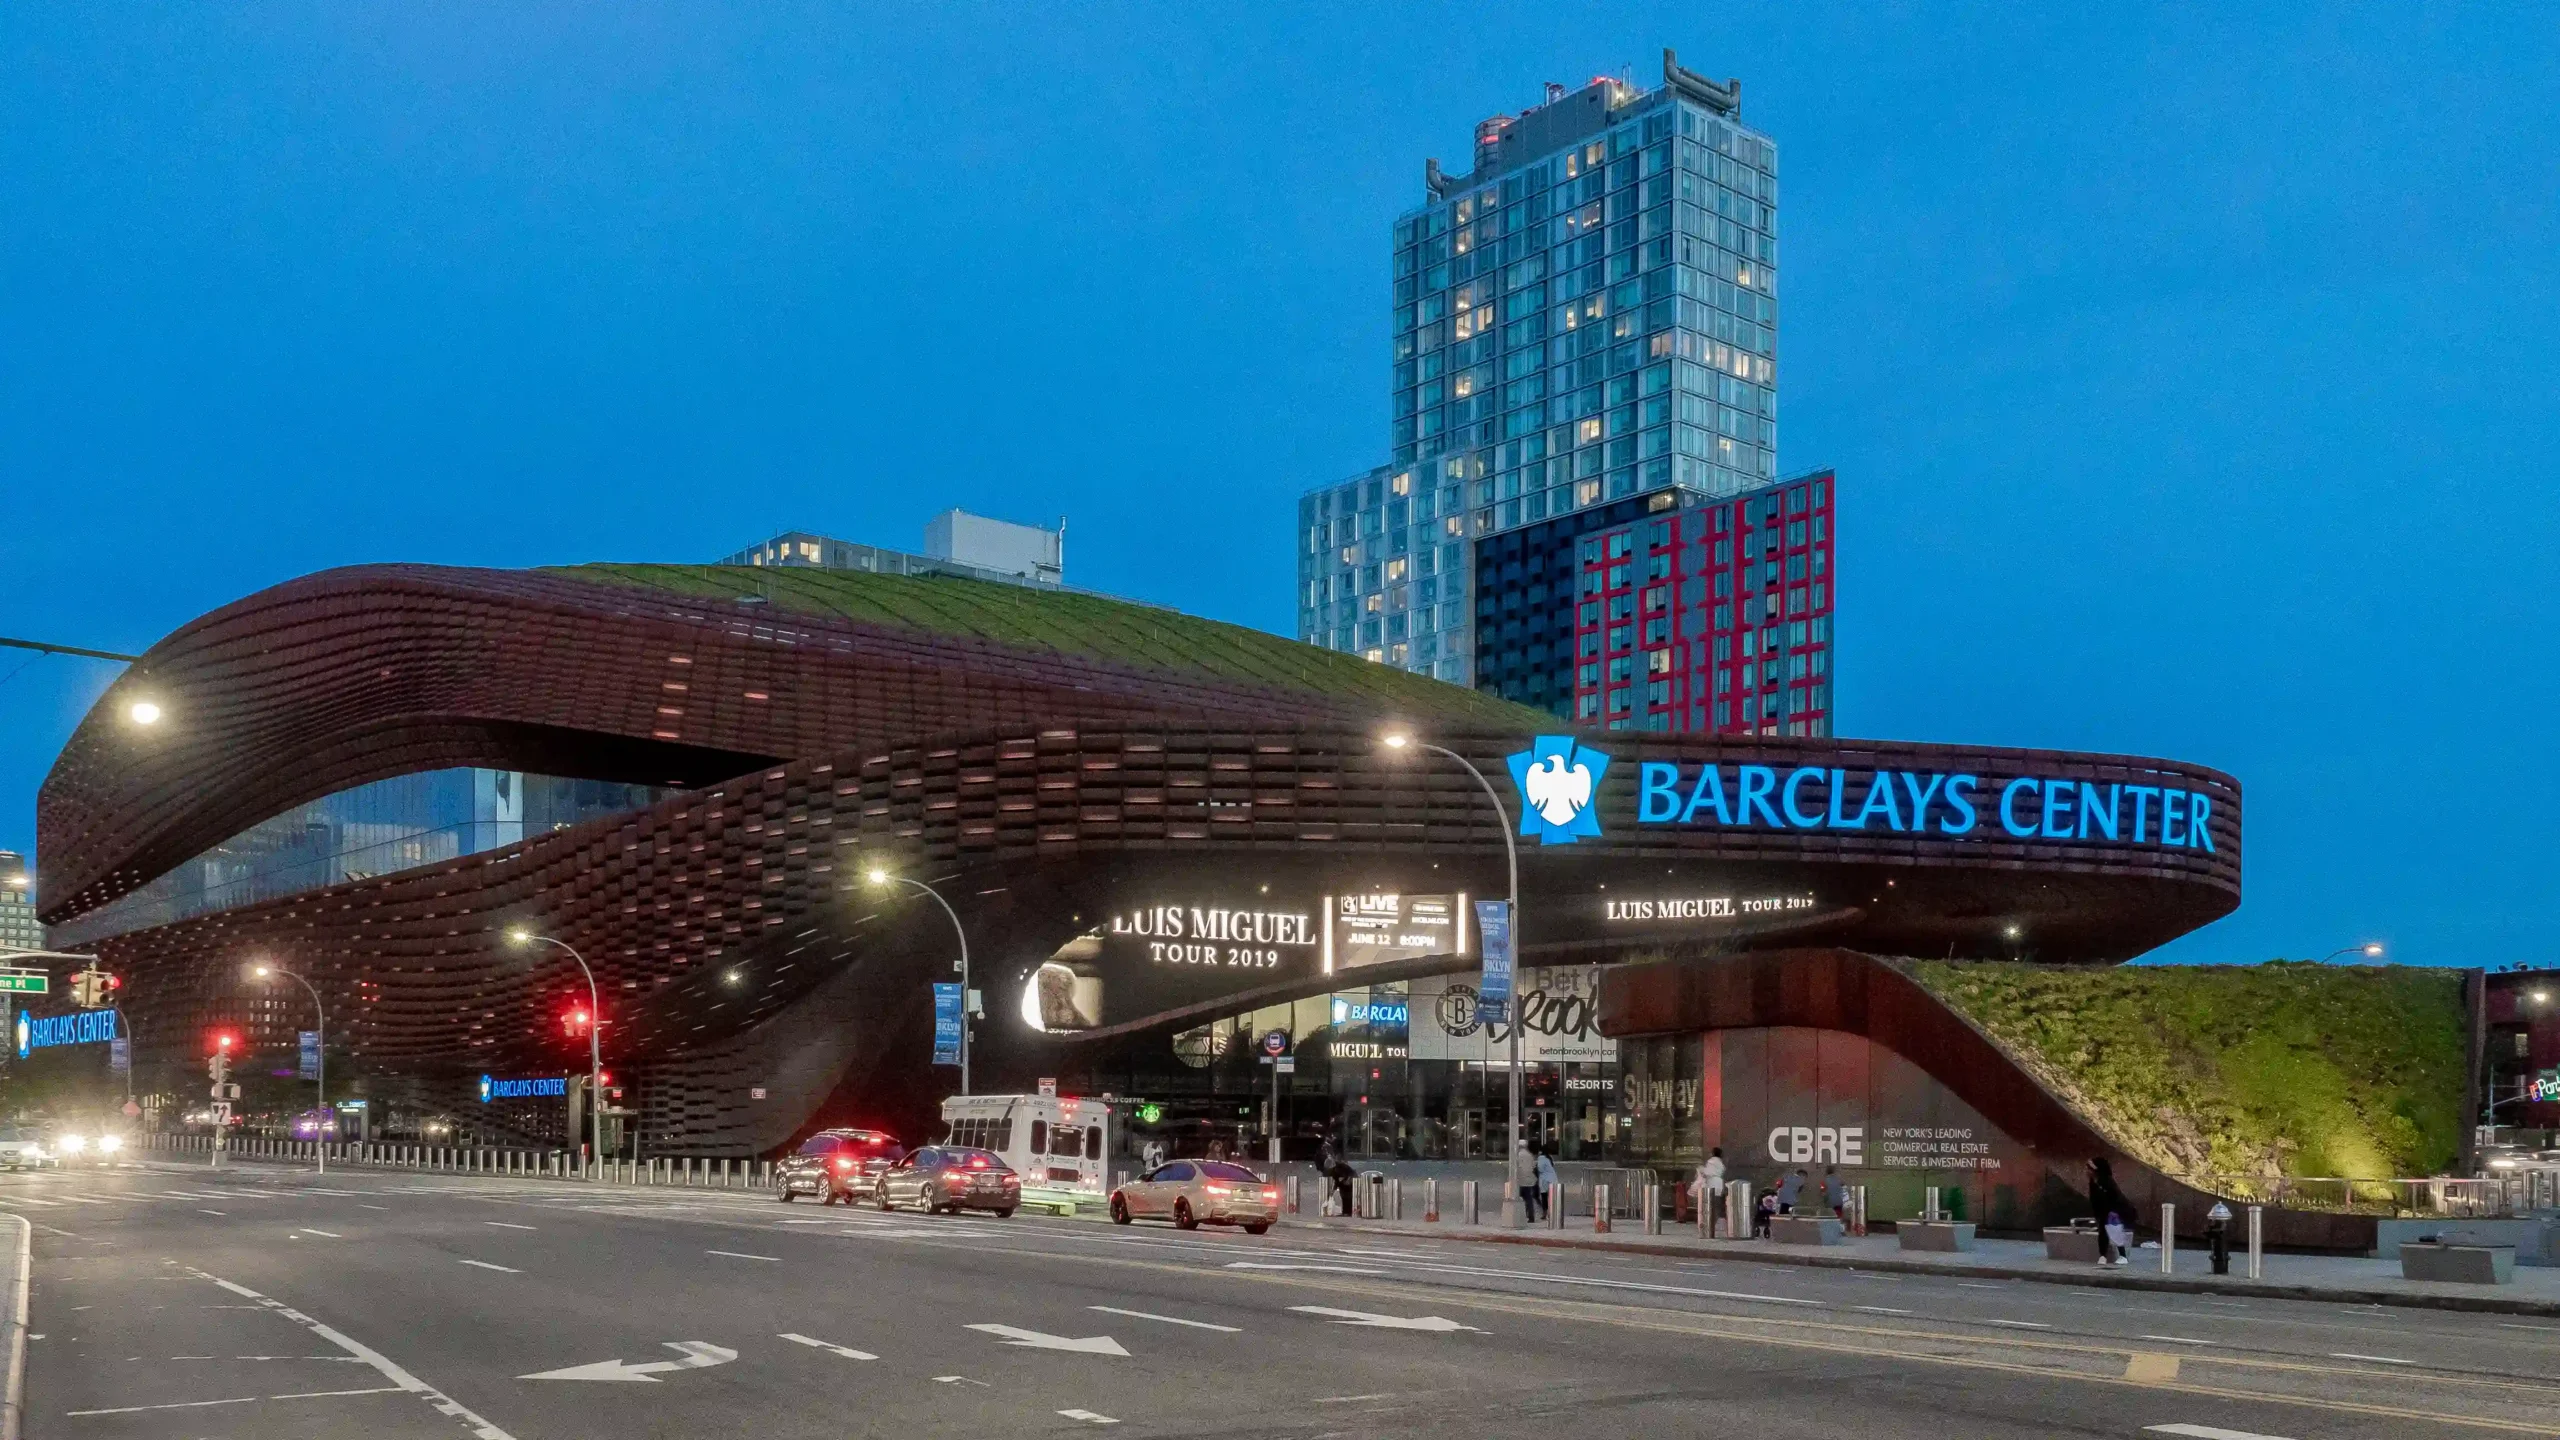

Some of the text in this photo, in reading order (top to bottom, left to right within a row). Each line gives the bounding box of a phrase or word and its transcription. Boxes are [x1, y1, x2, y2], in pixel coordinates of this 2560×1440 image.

[1638, 761, 2215, 852] BARCLAYS CENTER
[1360, 894, 1399, 911] LIVE
[1608, 898, 1813, 919] LUIS MIGUEL TOUR 2019
[1112, 906, 1315, 945] LUIS MIGUEL
[1348, 933, 1375, 945] JUNE
[1378, 934, 1391, 945] 12
[1151, 942, 1277, 967] TOUR 2019
[1484, 959, 1511, 973] BKLYN
[1536, 967, 1580, 992] Bet
[32, 1009, 116, 1047] BARCLAYS CENTER
[493, 1078, 565, 1096] BARCLAYS CENTER
[1566, 1079, 1614, 1090] RESORTS
[1883, 1128, 1972, 1139] NEW YORK'S LEADING
[1768, 1126, 1863, 1164] CBRE
[1883, 1142, 1989, 1153] COMMERCIAL REAL ESTATE
[1883, 1155, 2000, 1168] SERVICES & INVESTMENT FIRM
